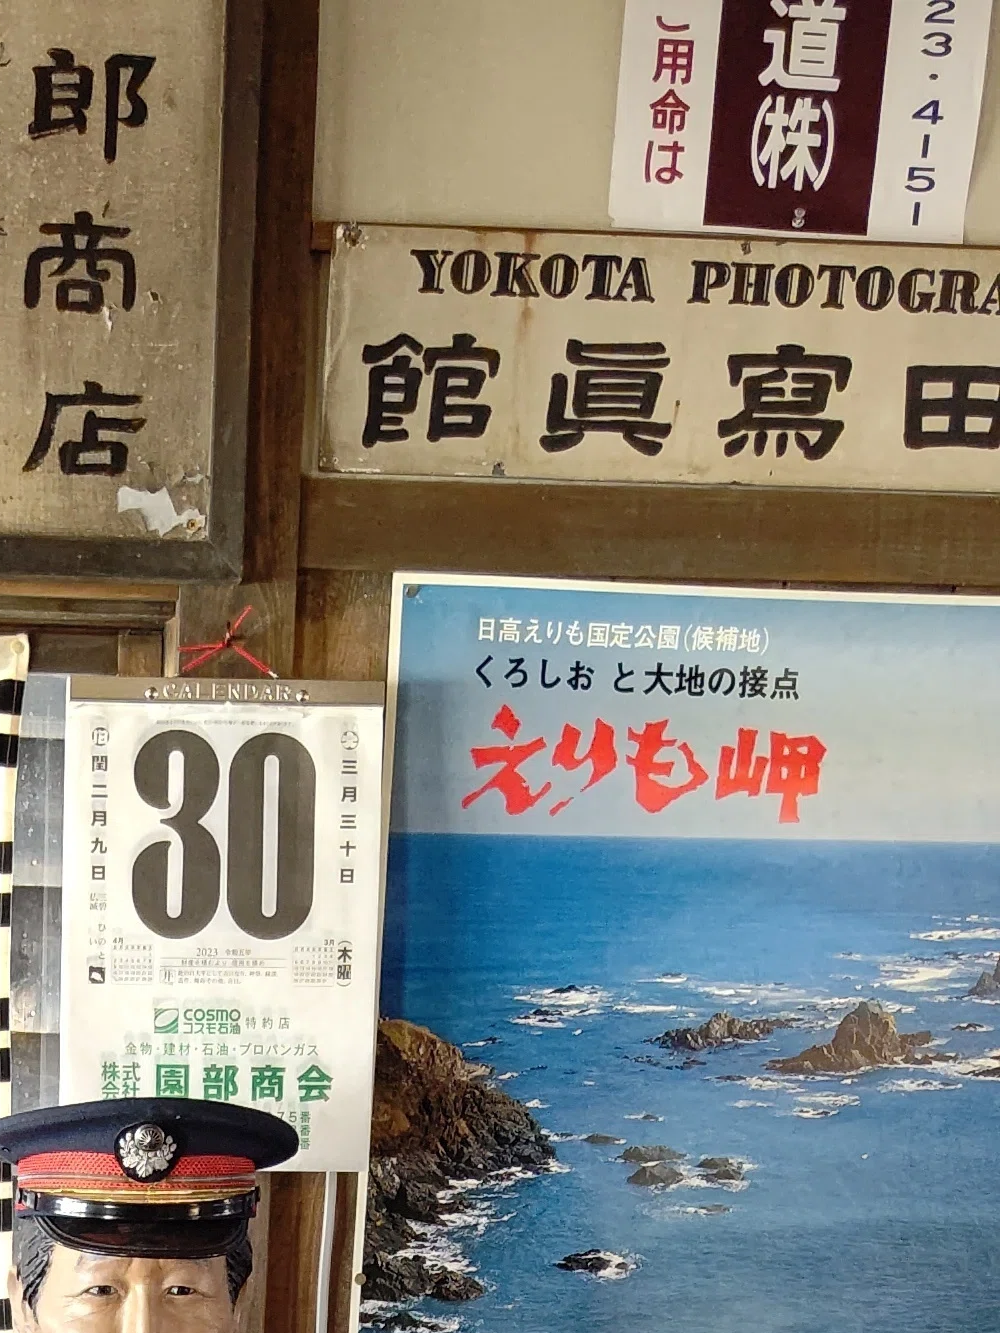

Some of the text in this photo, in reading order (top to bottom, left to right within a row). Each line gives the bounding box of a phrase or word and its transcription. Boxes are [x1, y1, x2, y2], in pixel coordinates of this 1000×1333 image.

[410, 249, 655, 303] YOKOTA
[162, 683, 293, 702] CALENDAR
[460, 704, 827, 824] えりも岬
[131, 729, 317, 941] 30
[339, 759, 358, 884] 三月三十日
[196, 947, 219, 958] 2023
[182, 1023, 241, 1035] コスモ石油
[245, 1017, 291, 1030] 特約店
[155, 1063, 334, 1102] 園部商会
